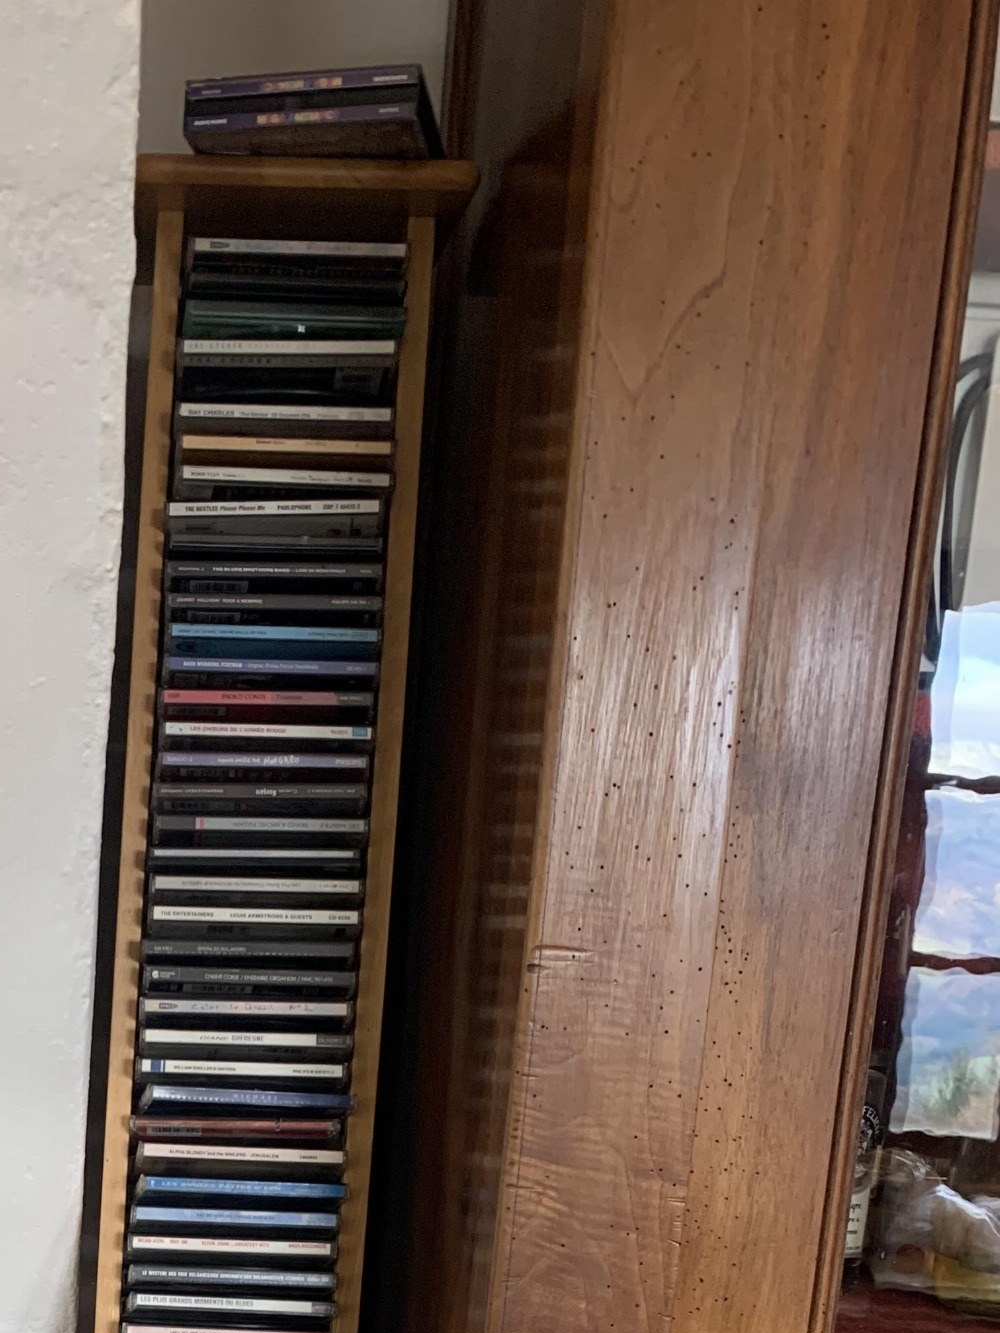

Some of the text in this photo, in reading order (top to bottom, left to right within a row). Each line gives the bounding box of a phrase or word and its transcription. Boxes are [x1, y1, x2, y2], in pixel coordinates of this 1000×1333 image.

[140, 1295, 151, 1303] LES
[168, 1296, 193, 1304] GRANDS
[234, 1299, 254, 1307] BLUES
